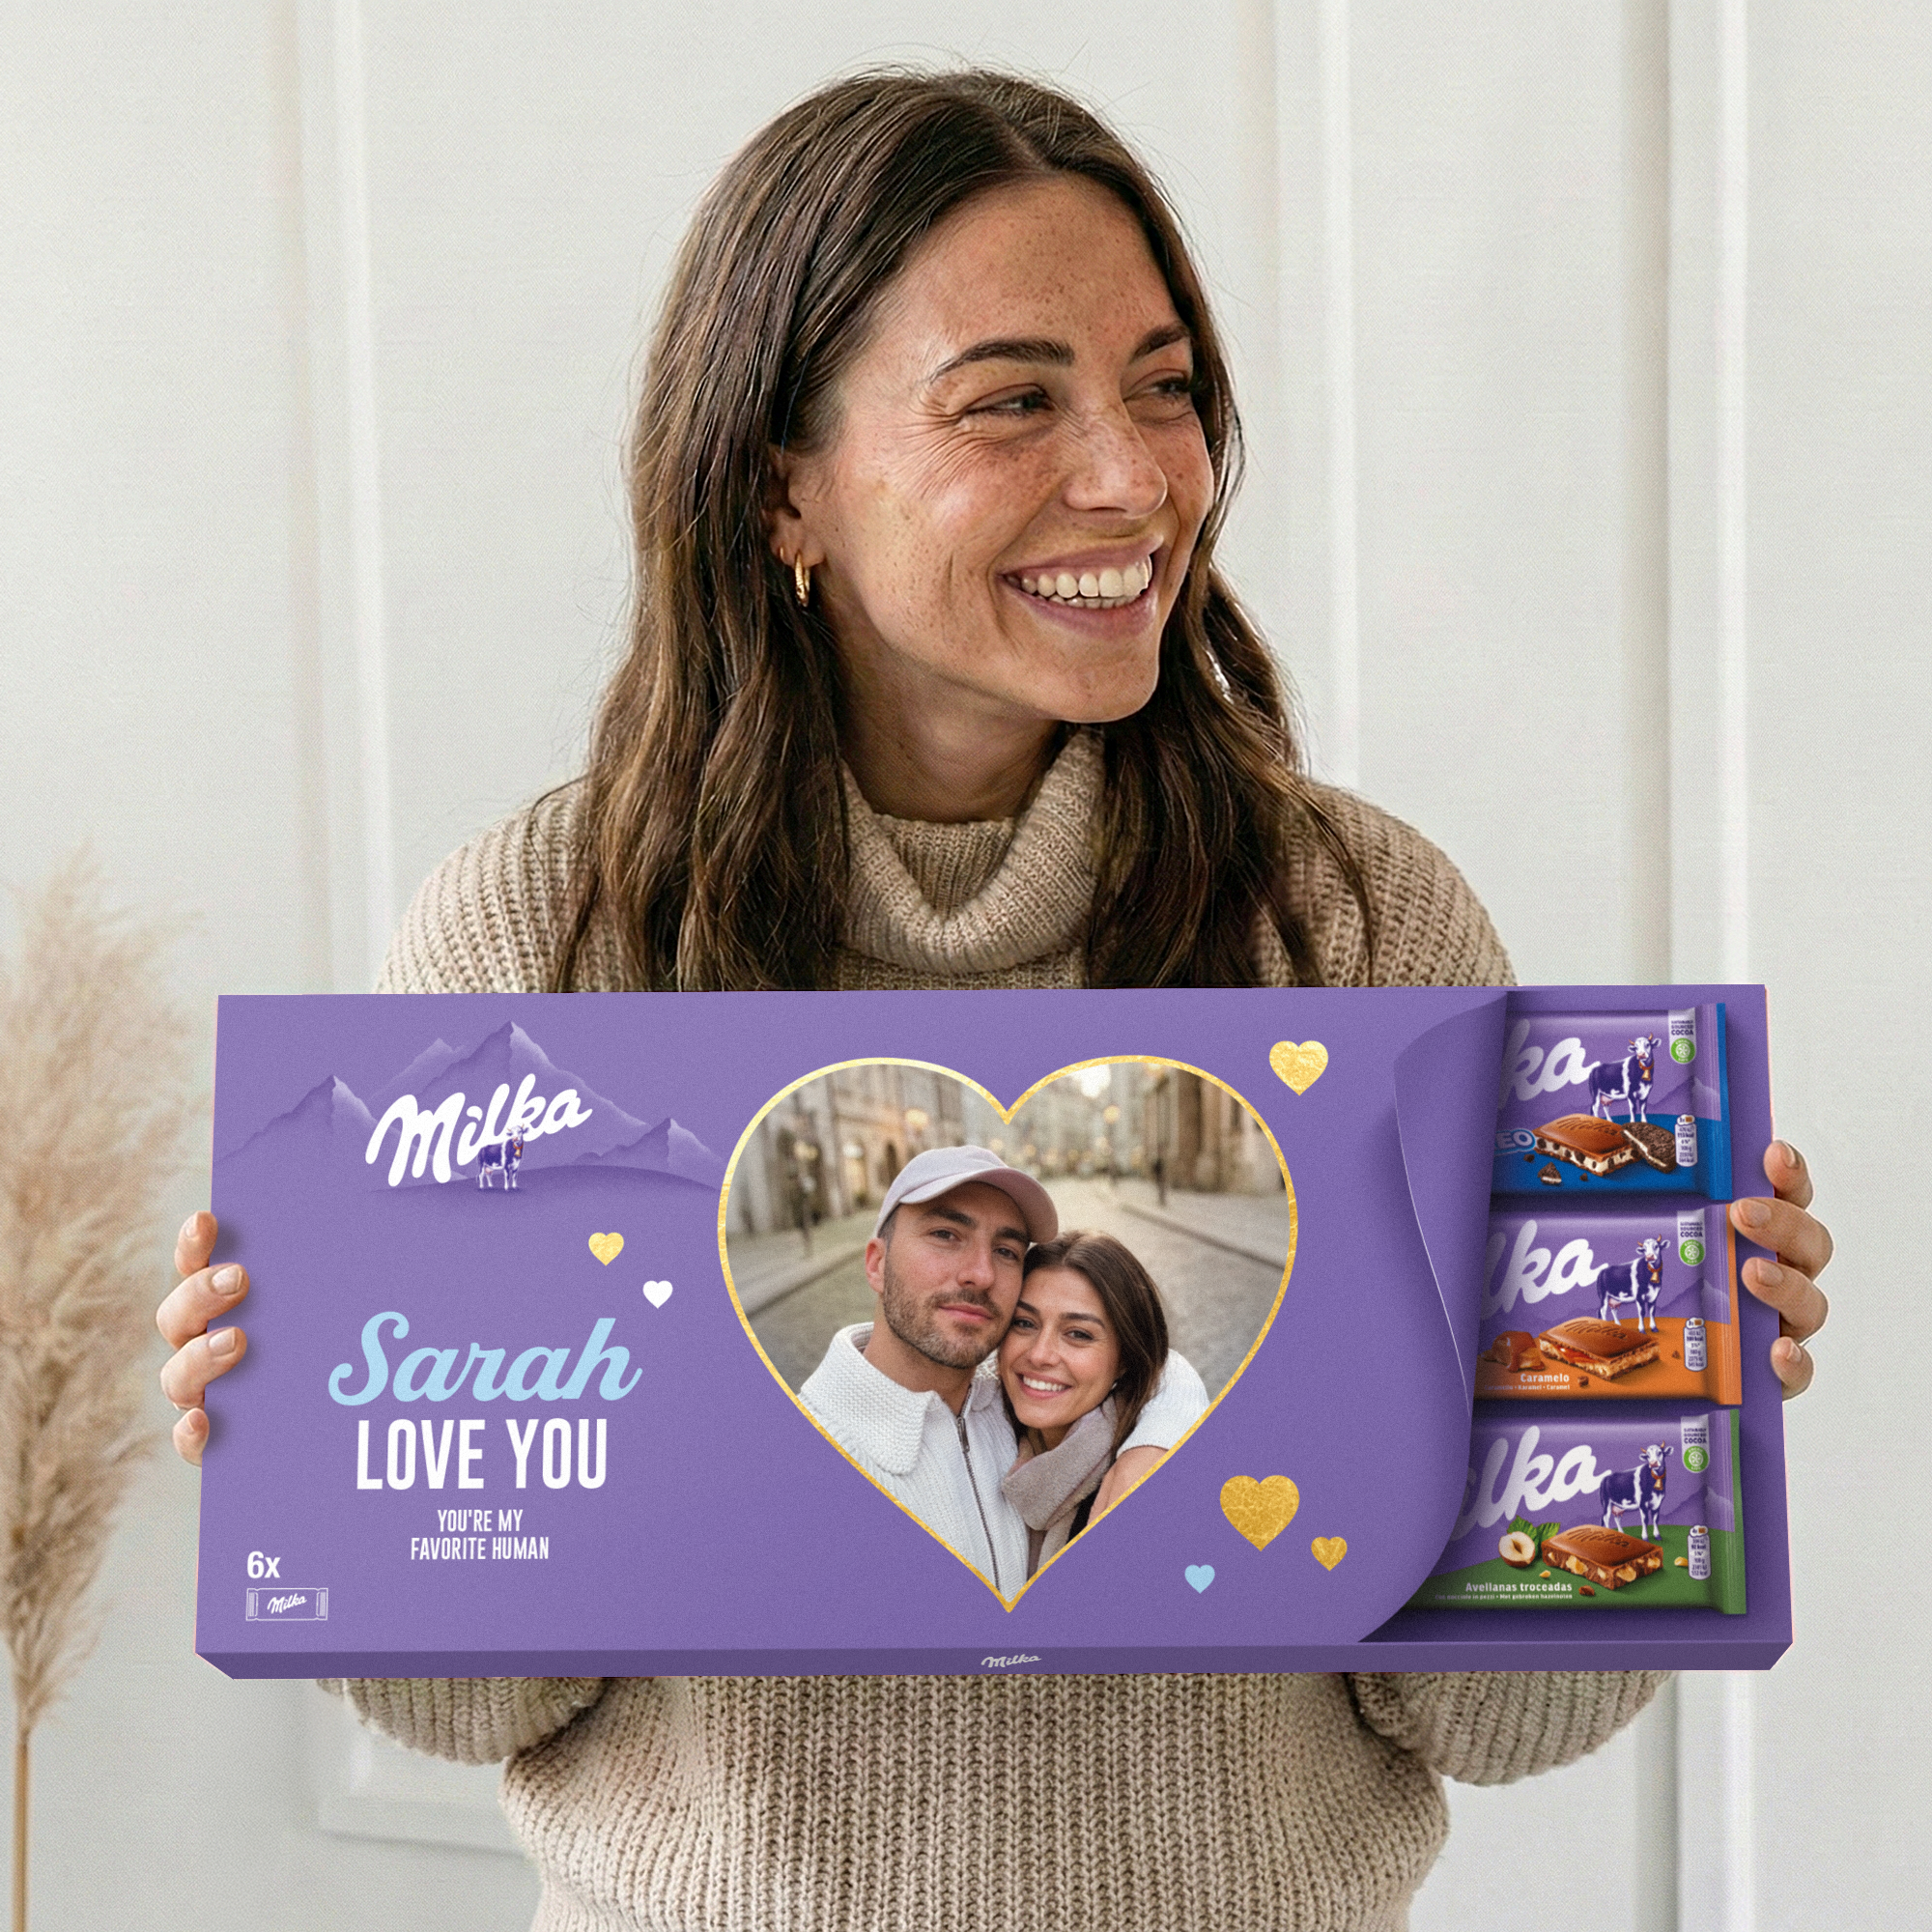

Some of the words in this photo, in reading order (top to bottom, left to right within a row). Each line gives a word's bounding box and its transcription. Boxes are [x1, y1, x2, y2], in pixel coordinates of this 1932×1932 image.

[365, 1072, 593, 1187] Milka
[1496, 1130, 1533, 1149] EO
[1480, 1219, 1609, 1321] lka
[328, 1311, 643, 1406] Sarah
[1520, 1373, 1570, 1382] Caramelo
[356, 1419, 485, 1491] LOVE
[507, 1418, 608, 1490] YOU
[437, 1509, 493, 1532] YOU'RE
[498, 1509, 525, 1532] MY
[411, 1538, 487, 1561] FAVORITE
[492, 1537, 550, 1560] HUMAN
[246, 1550, 281, 1579] 6x
[1465, 1582, 1518, 1592] Avellanas
[1520, 1582, 1573, 1592] troceadas
[267, 1593, 308, 1614] Milka
[980, 1653, 1042, 1668] Milka
